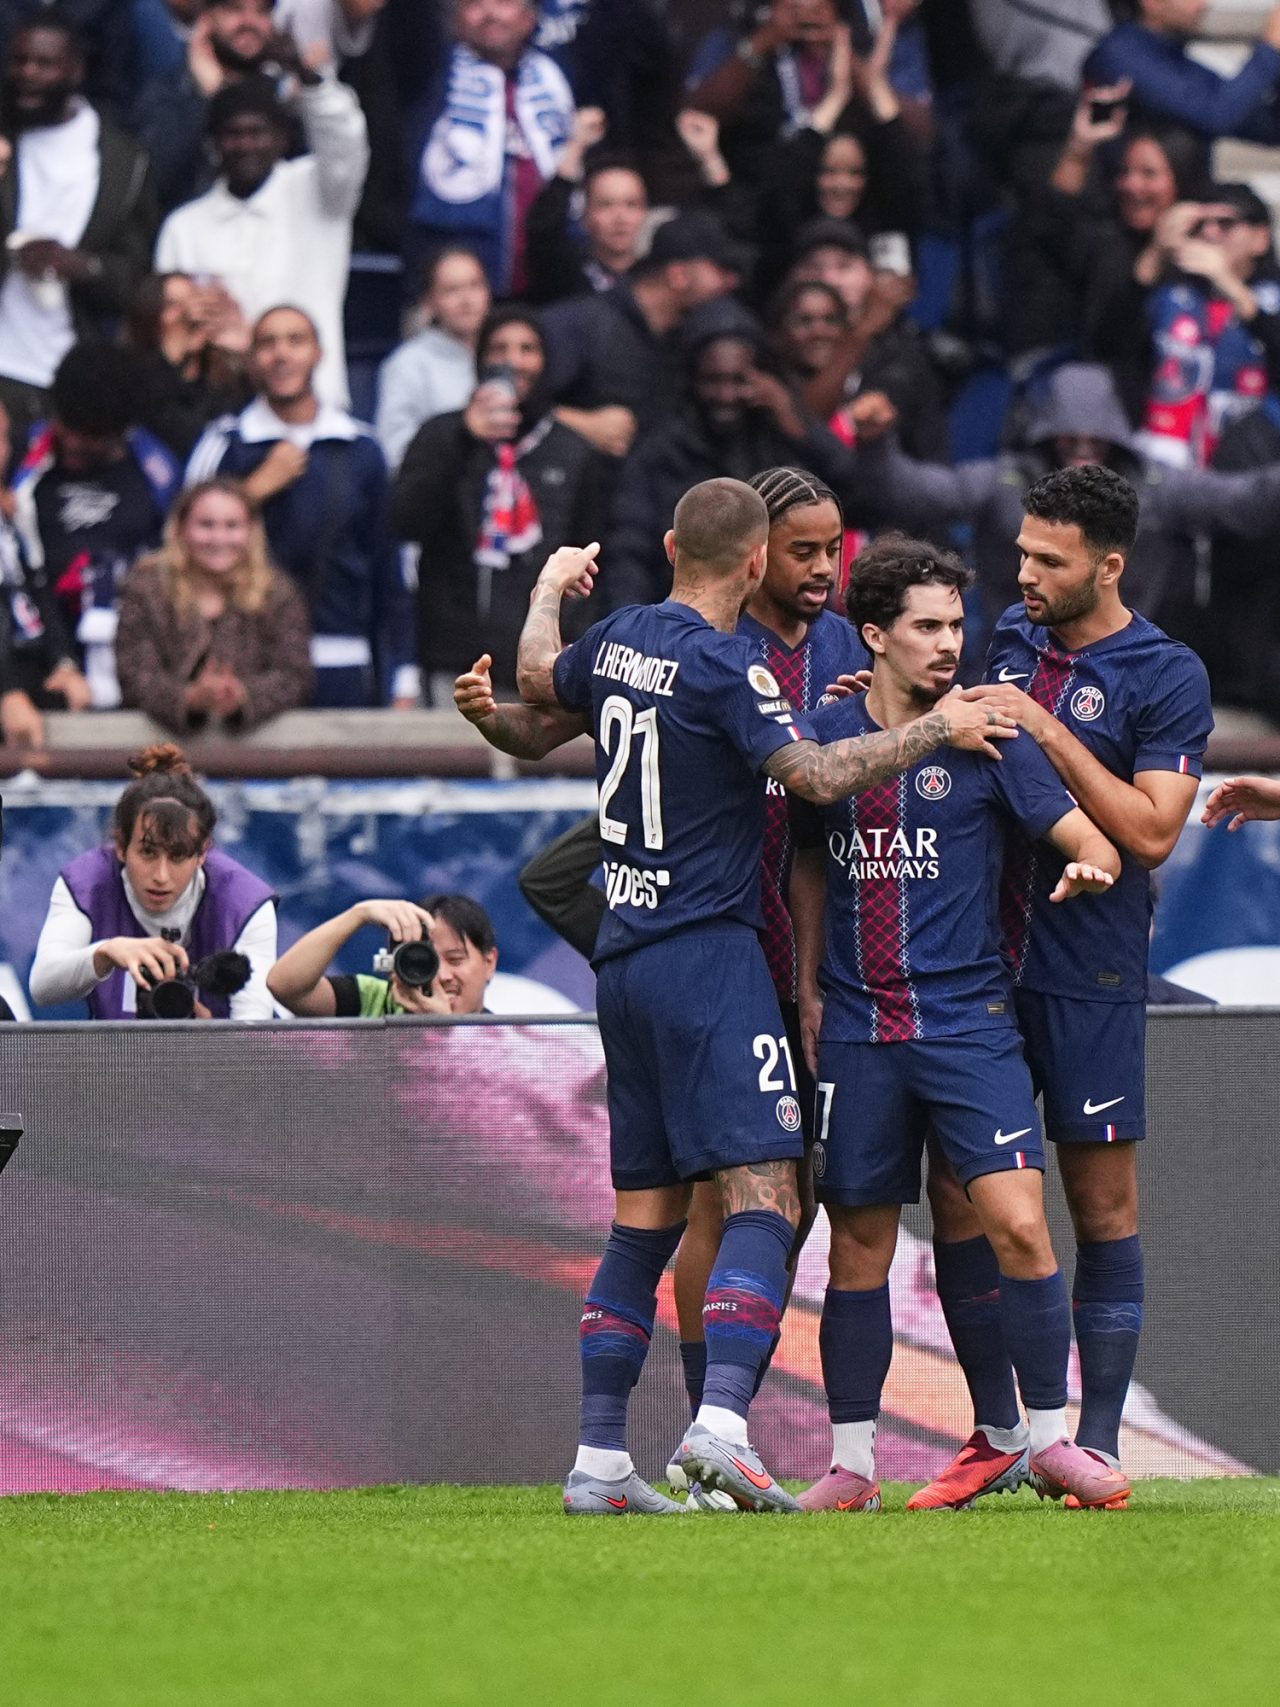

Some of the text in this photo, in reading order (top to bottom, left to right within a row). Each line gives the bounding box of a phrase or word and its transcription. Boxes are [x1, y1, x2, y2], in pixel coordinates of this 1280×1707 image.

[599, 695, 663, 850] 21
[829, 827, 940, 867] QATAR
[848, 860, 940, 880] AIRWAYS
[752, 1033, 798, 1093] 21
